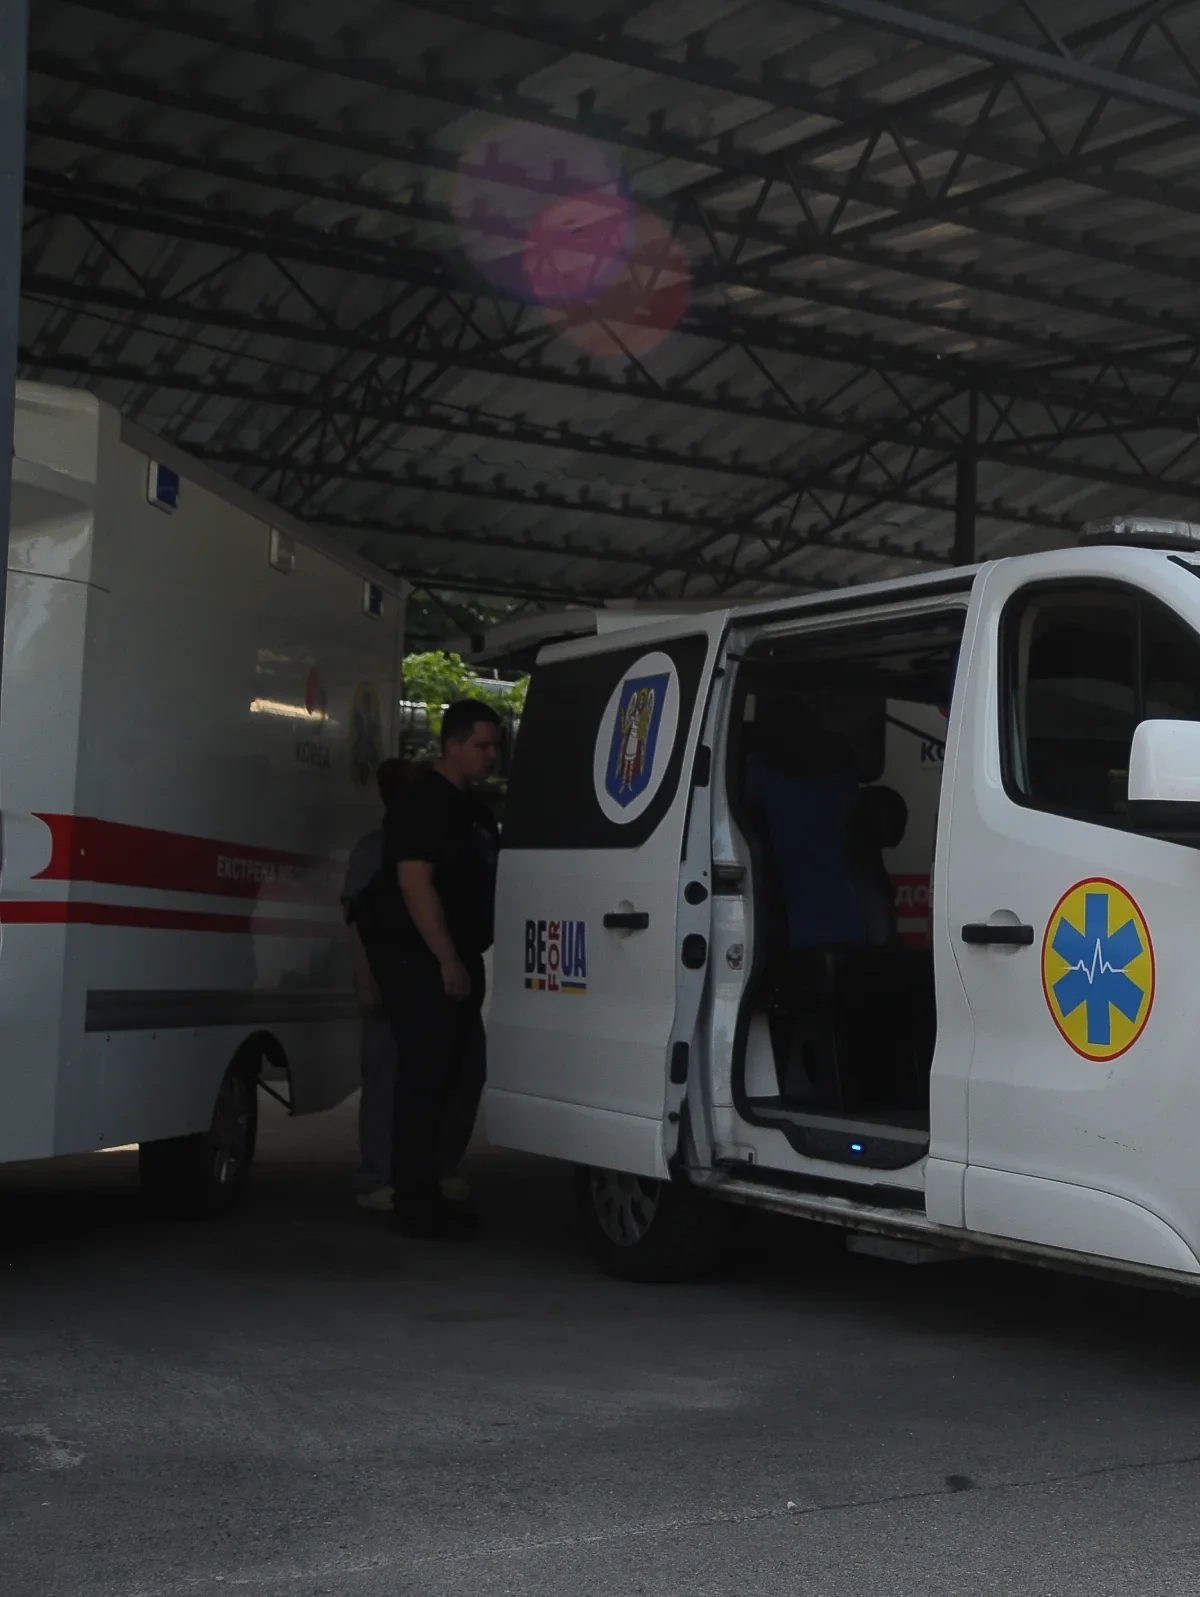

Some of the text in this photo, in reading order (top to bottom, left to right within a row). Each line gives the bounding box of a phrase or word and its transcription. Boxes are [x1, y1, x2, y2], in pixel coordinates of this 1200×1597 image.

[525, 920, 587, 991] BE FOR UA
